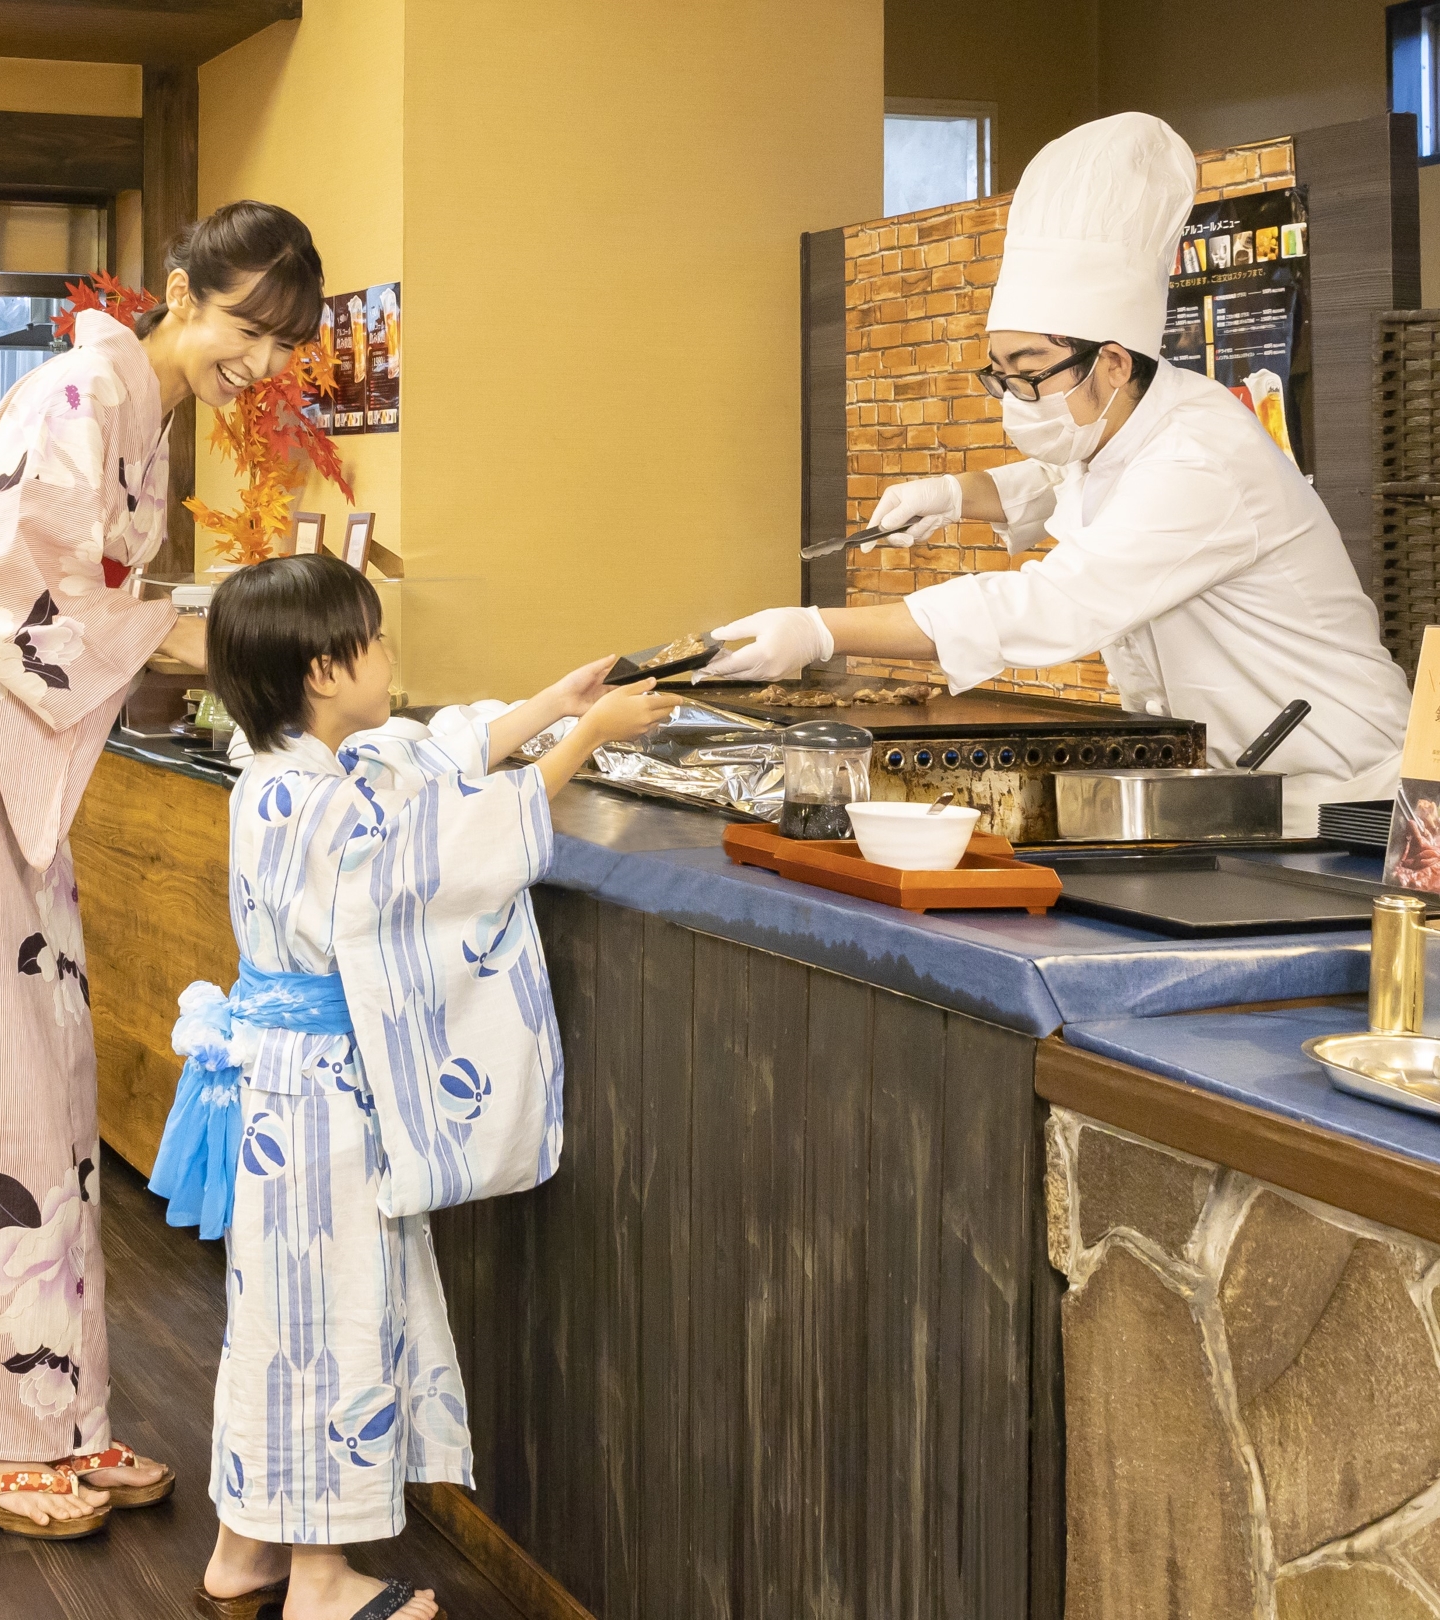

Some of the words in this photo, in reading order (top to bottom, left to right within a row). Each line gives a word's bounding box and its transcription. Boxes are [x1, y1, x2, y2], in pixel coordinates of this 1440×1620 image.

[1182, 220, 1241, 236] アルコールメニュー
